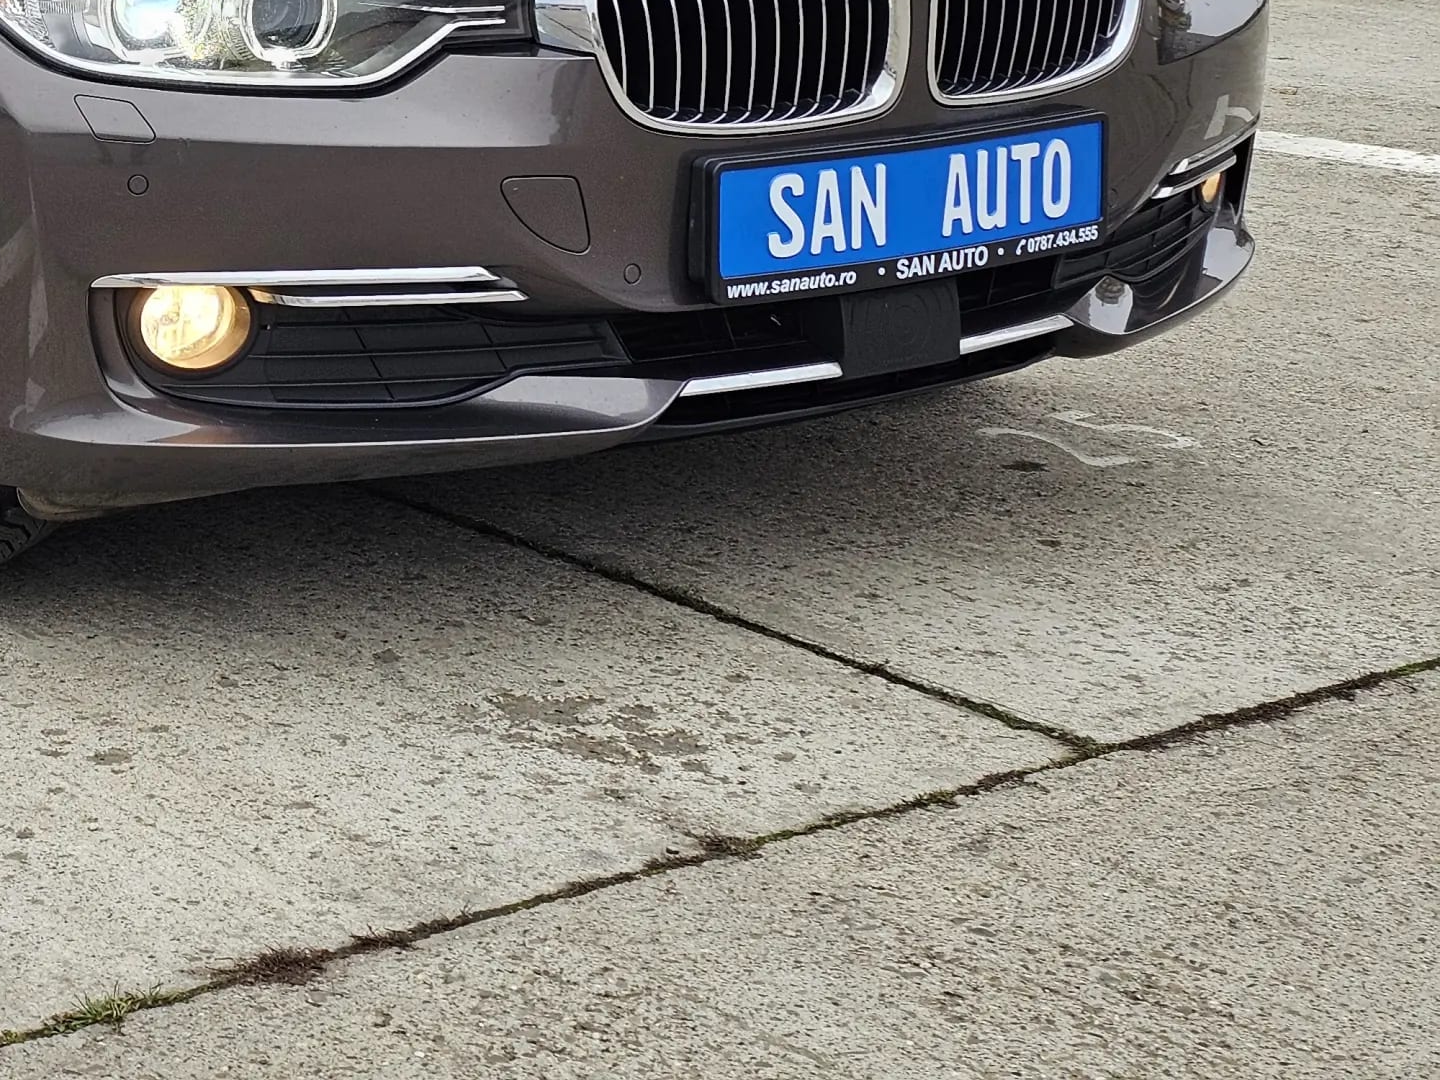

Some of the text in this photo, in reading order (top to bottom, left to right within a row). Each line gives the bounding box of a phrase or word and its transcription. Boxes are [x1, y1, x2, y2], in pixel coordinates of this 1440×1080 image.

[767, 137, 1072, 259] SAN AUTO
[726, 224, 1100, 299] www.sanauto.ro SAN AUTO 0787.434.555
